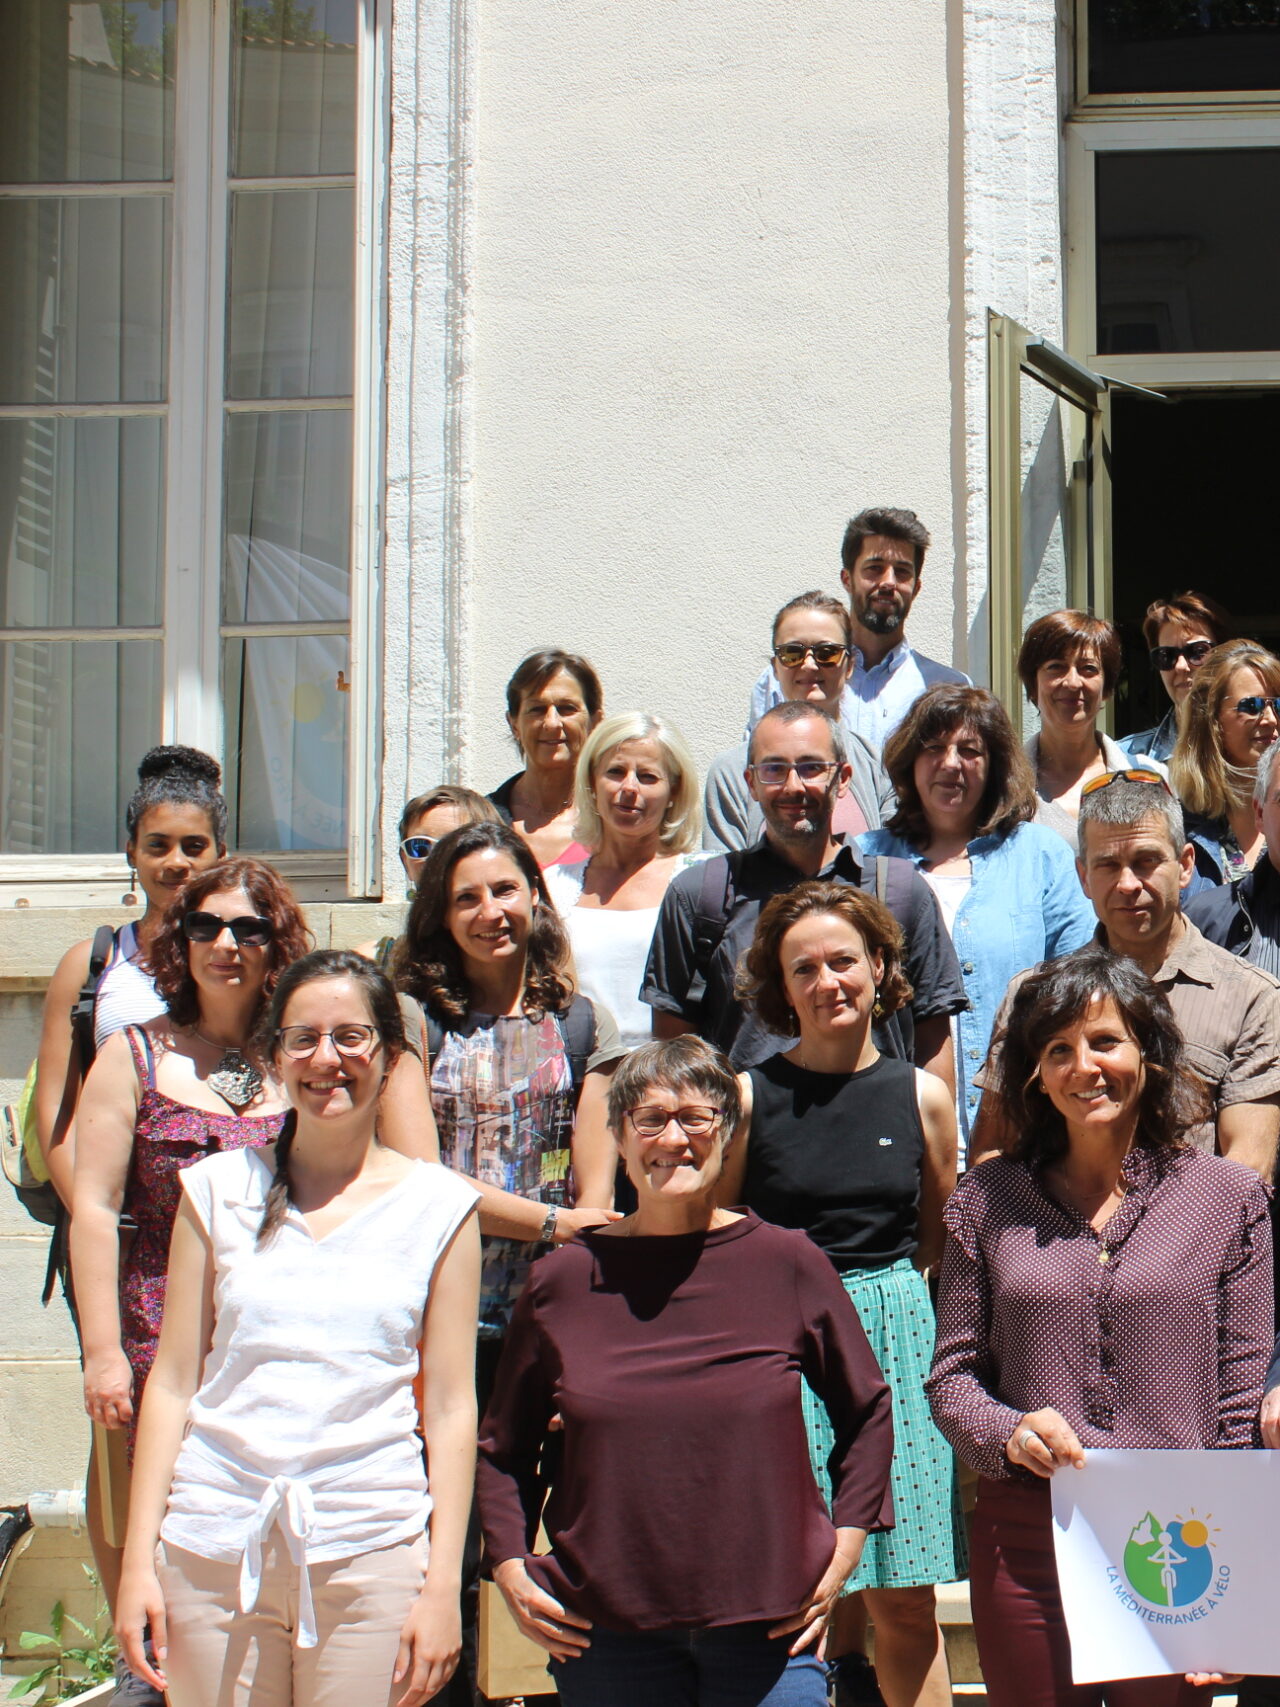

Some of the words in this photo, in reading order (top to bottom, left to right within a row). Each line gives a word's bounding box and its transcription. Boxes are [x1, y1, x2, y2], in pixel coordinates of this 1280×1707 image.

[1106, 1566, 1119, 1583] LA
[1113, 1584, 1208, 1625] MÉDITERRANÉE
[1205, 1597, 1219, 1610] À
[1213, 1565, 1231, 1597] VÉLO
